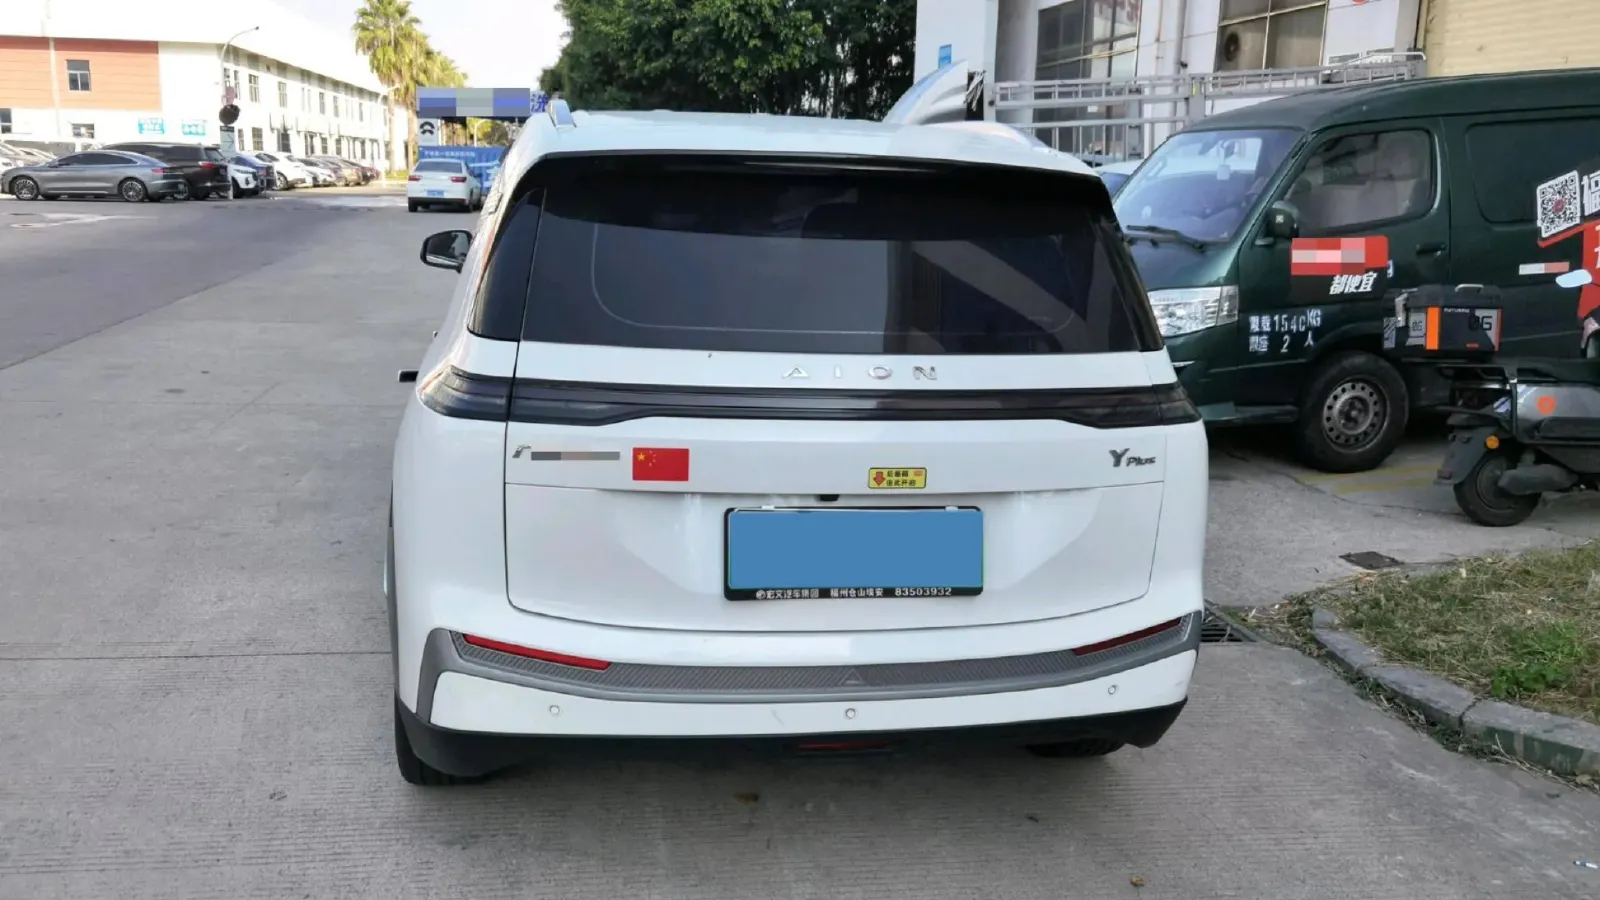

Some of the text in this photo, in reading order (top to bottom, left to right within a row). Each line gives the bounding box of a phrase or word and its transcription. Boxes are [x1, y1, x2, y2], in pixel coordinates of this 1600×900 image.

[1329, 271, 1377, 295] 都便宜
[782, 364, 938, 381] AION
[895, 587, 952, 596] 83503932
